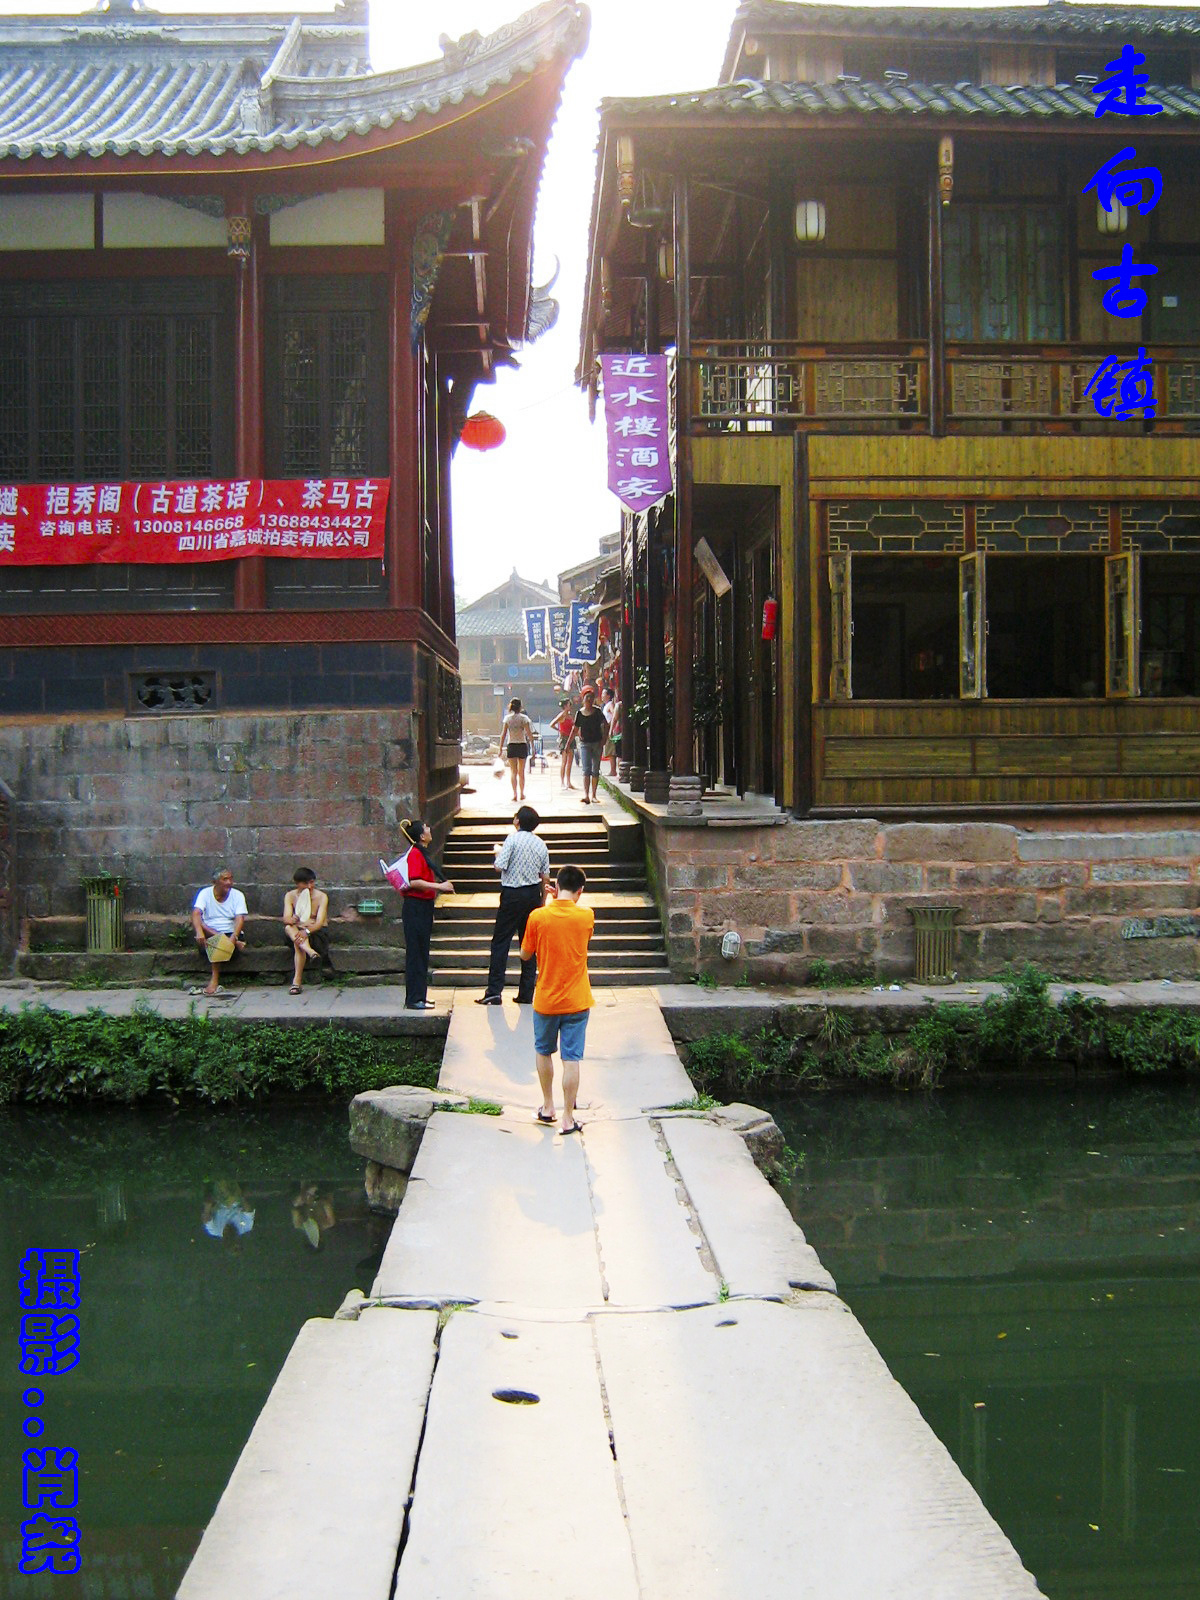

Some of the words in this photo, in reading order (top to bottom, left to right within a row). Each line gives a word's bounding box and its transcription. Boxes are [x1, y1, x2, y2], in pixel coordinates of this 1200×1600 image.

[134, 515, 244, 534] 13008146668
[259, 513, 373, 529] 13688434427
[178, 528, 370, 552] 四川省嘉诚拍卖有限公司
